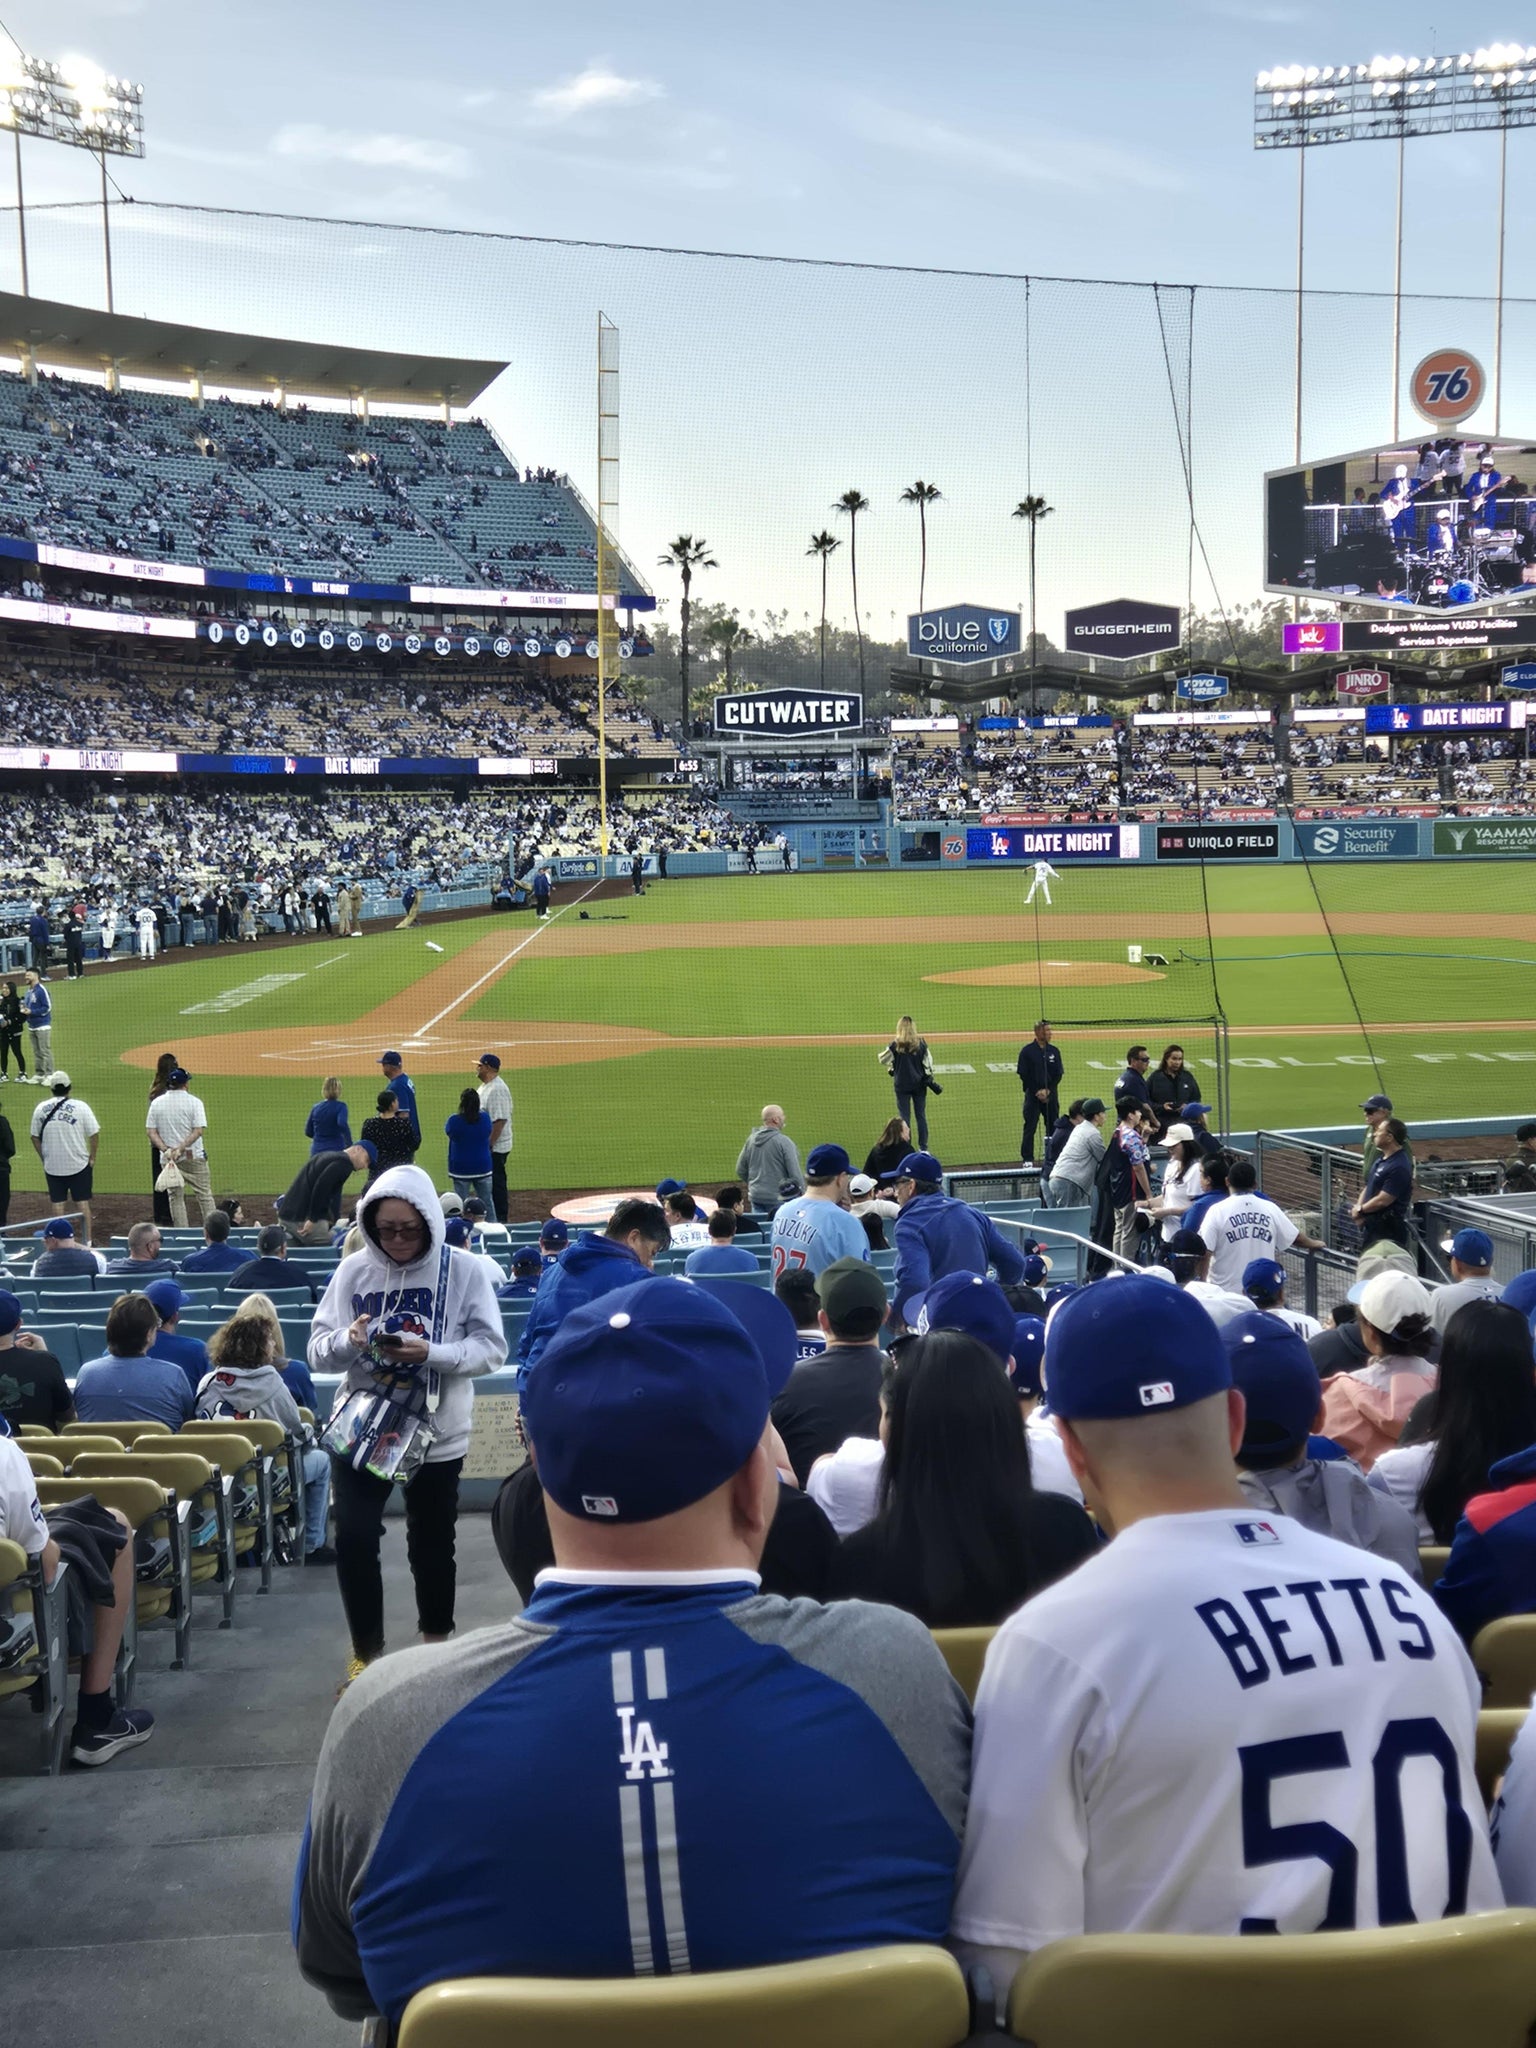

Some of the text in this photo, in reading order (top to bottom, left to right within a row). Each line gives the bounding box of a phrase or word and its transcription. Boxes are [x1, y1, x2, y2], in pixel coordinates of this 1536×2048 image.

[1424, 366, 1472, 404] 76
[134, 564, 146, 574] DATE
[312, 582, 350, 594] DATE NIGHT
[530, 596, 546, 604] DATE
[214, 627, 218, 638] 1
[919, 616, 980, 641] blue
[1074, 623, 1172, 635] GUGGENHEIM
[1371, 619, 1518, 634] Dodgers Welcome VUSD Facilities
[240, 630, 246, 640] 2
[267, 631, 273, 642] 4
[294, 633, 302, 643] 14
[322, 635, 331, 646] 19
[350, 636, 360, 647] 20
[1399, 635, 1488, 646] Services Department
[378, 638, 390, 648] 24
[407, 639, 419, 650] 32
[437, 641, 449, 651] 34
[467, 642, 478, 652] 39
[496, 640, 510, 654] 42
[527, 643, 539, 653] 53
[928, 642, 988, 653] california
[1183, 679, 1215, 688] TOYO
[1345, 673, 1382, 690] JINRO
[725, 700, 850, 724] CUTWATER
[1393, 708, 1408, 728] LA
[1423, 708, 1504, 726] DATE NIGHT
[80, 751, 124, 769] DATE NIGHT
[325, 757, 380, 774] DATE NIGHT
[679, 760, 698, 772] 6:55
[1344, 827, 1396, 841] Security
[945, 842, 962, 855] 76
[991, 832, 1008, 855] LA
[1024, 833, 1112, 852] DATE NIGHT
[1188, 837, 1233, 849] UNIQLO
[1237, 836, 1274, 847] FIELD
[1345, 840, 1389, 853] Benefit
[1229, 1212, 1270, 1228] DODGERS
[774, 1219, 817, 1245] SUZUKI
[1226, 1226, 1272, 1244] BLUE CREW
[773, 1246, 807, 1278] 27
[352, 1288, 435, 1321] DODGER
[1194, 1577, 1436, 1690] BETTS
[616, 1707, 668, 1780] LA
[1238, 1717, 1474, 1936] 50
